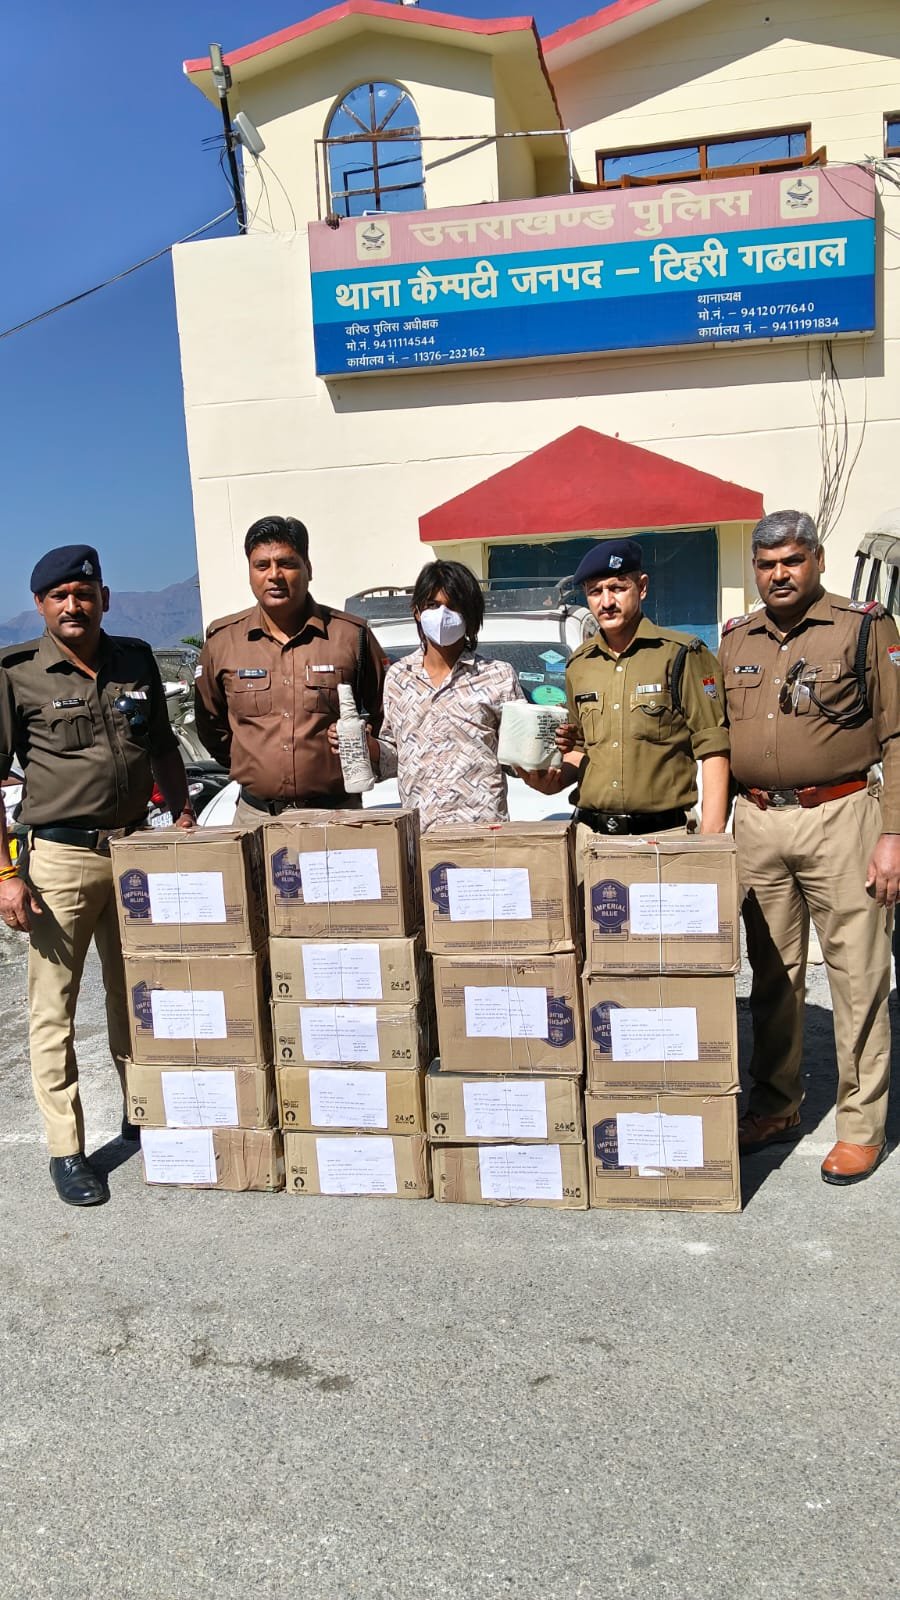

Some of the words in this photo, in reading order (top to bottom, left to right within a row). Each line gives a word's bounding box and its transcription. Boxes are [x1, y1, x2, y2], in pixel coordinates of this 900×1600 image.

[408, 205, 616, 247] उत्तराखण्ड
[628, 187, 752, 237] पुलिस
[336, 279, 401, 310] थाना
[408, 259, 499, 304] कैम्पटी
[508, 260, 604, 295] जनपद
[650, 237, 728, 283] टिहरी
[738, 237, 847, 273] गढवाल
[741, 302, 815, 318] 9412077640
[345, 322, 370, 335] वरिष्ठ
[373, 319, 400, 337] पुलिस
[698, 323, 740, 338] कार्यालय
[772, 317, 840, 332] 9411191834
[373, 336, 436, 350] 9411114544
[347, 352, 385, 368] कार्यालय
[123, 889, 149, 898] IMPERIA
[593, 903, 626, 913] IMPERIAL
